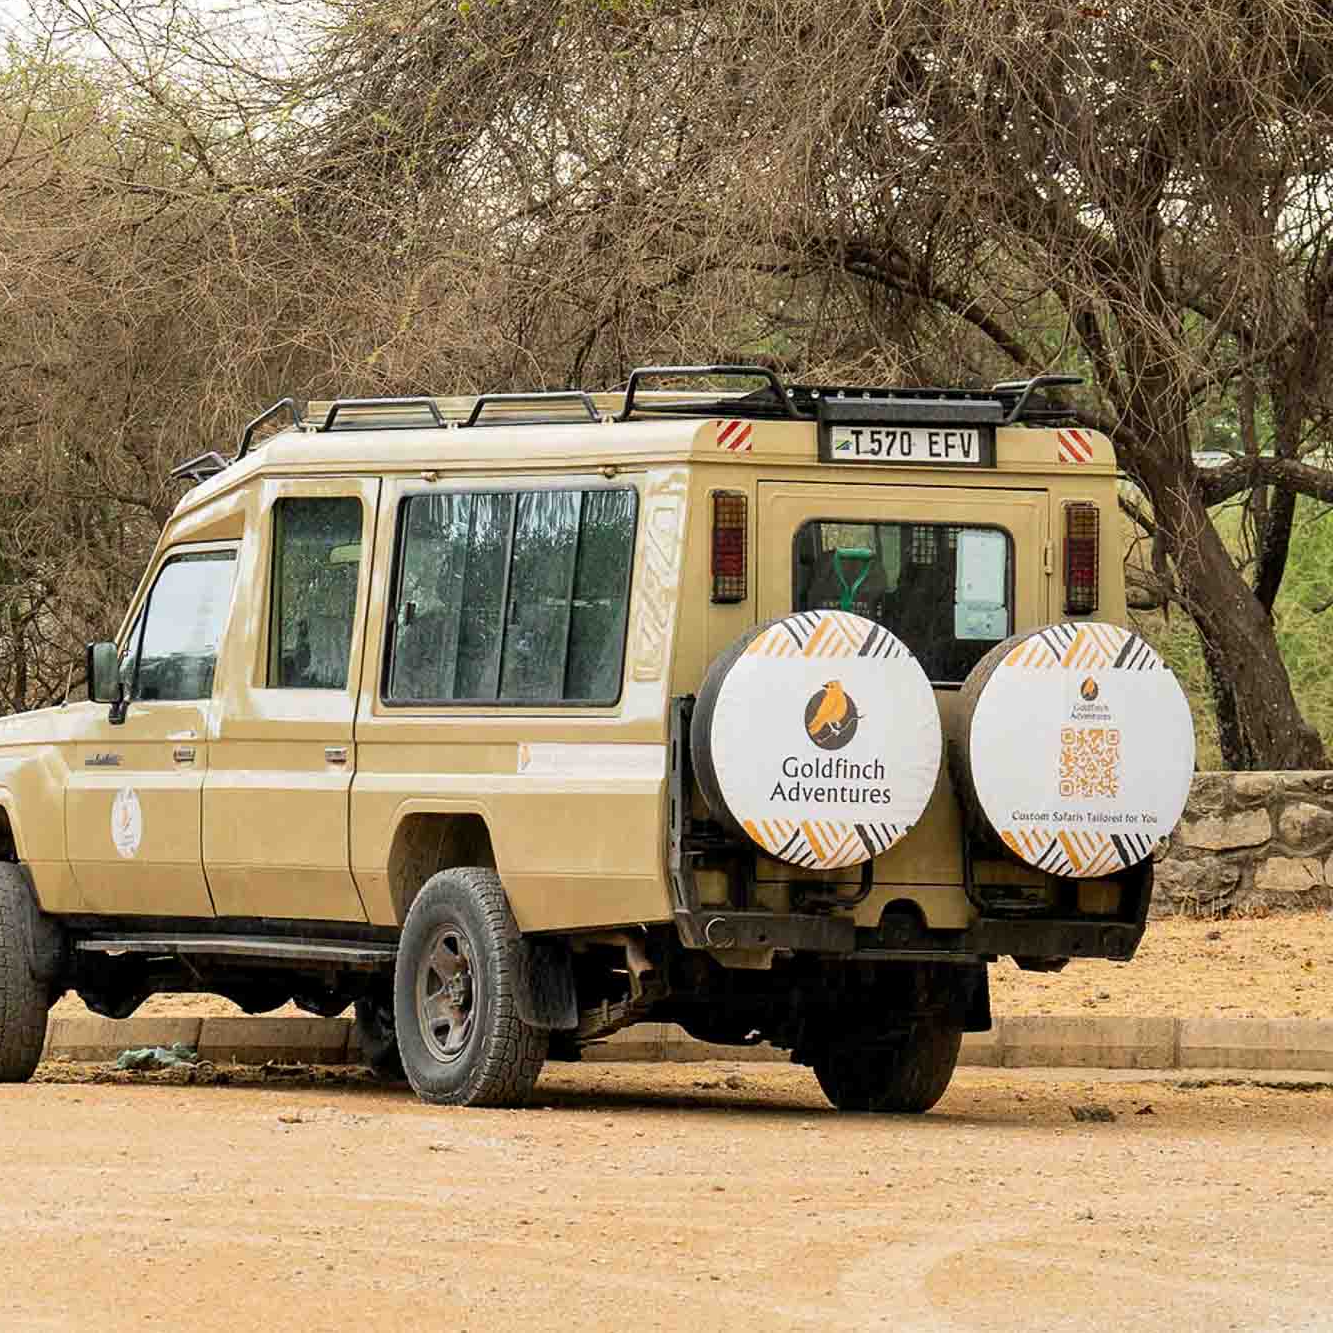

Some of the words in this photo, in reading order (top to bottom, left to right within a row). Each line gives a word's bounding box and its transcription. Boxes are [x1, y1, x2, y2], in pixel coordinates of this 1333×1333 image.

[928, 432, 972, 458] EFV
[782, 756, 885, 779] Goldfinch
[770, 781, 891, 804] Adventures
[1012, 811, 1050, 822] Custom
[1052, 811, 1083, 822] Safaris
[1086, 812, 1122, 823] Tailored
[1125, 813, 1138, 823] for
[1141, 813, 1157, 824] You
